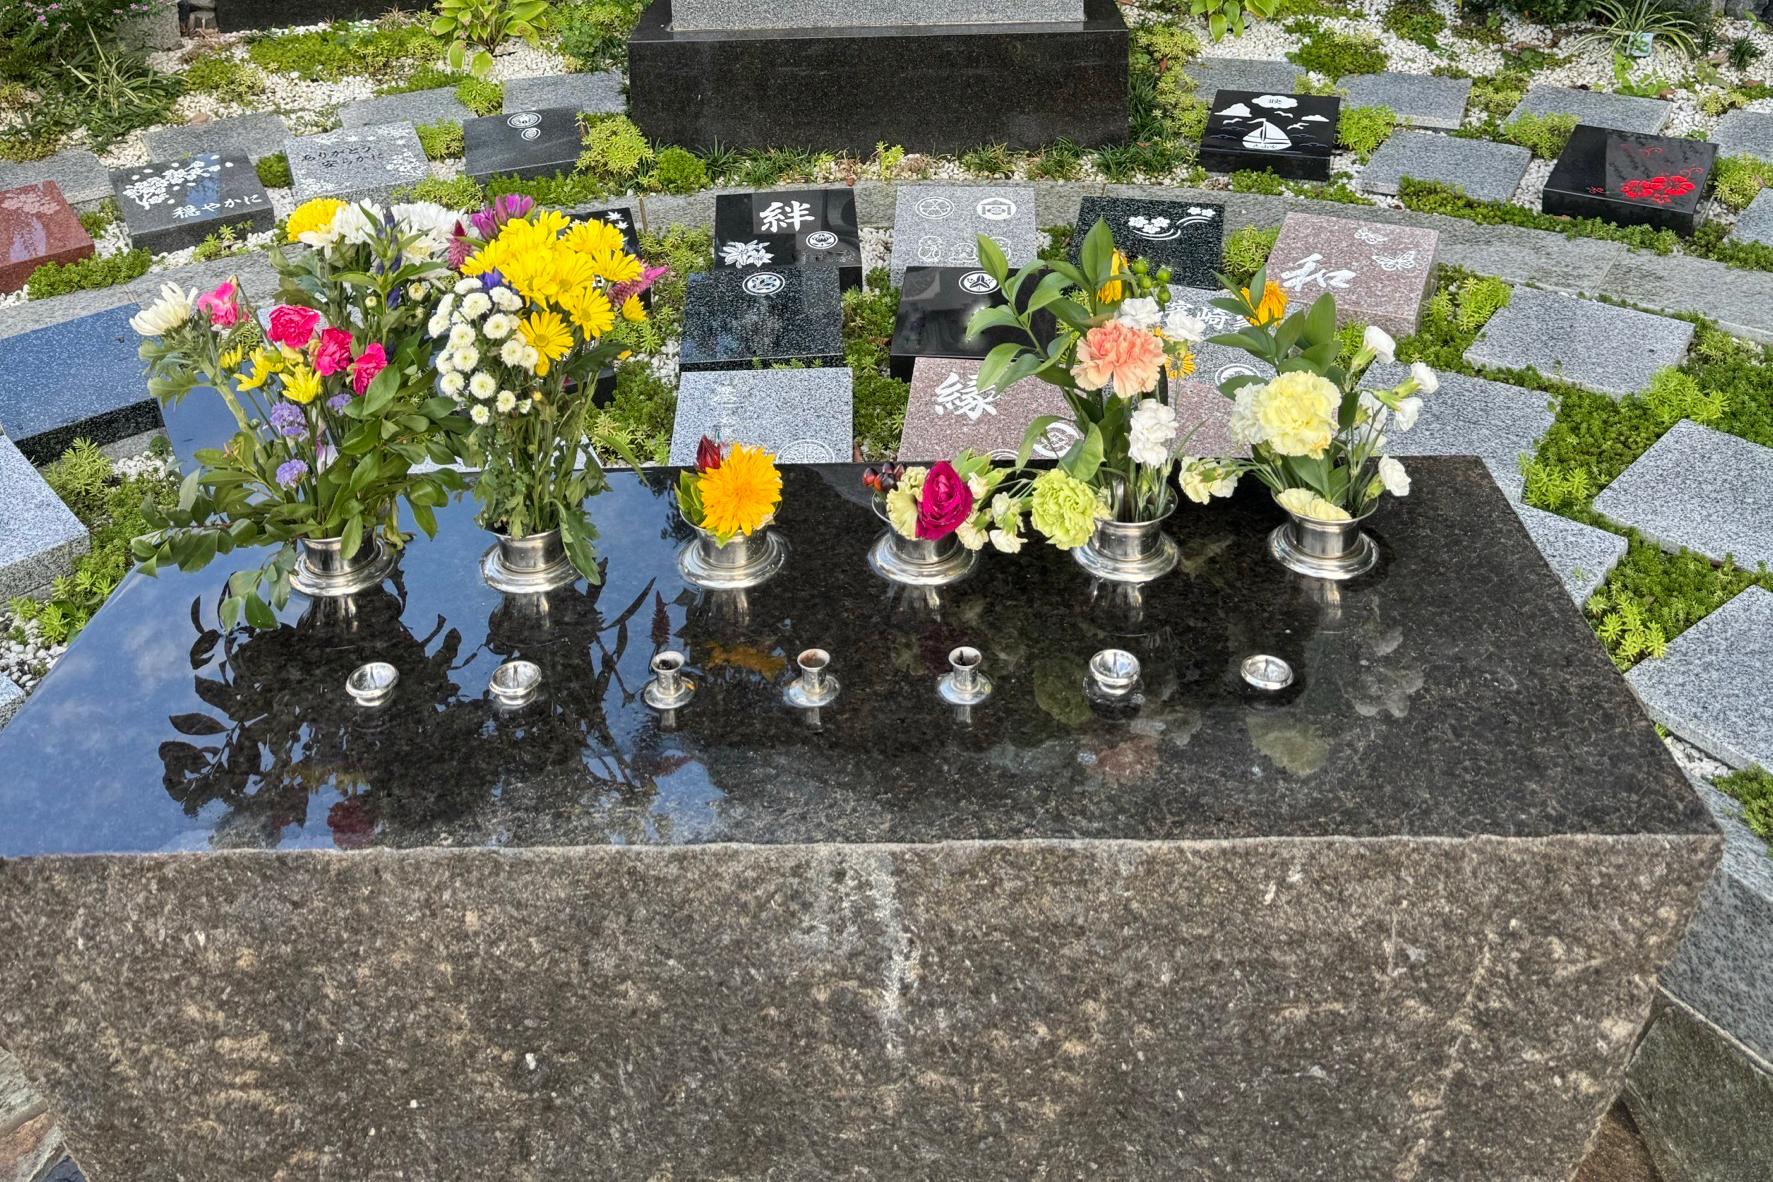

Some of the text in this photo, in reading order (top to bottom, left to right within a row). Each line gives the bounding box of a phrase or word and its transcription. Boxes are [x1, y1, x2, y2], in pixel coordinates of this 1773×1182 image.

[173, 194, 263, 219] 穏やかに
[759, 200, 815, 233] 絆
[1280, 253, 1357, 292] 和
[935, 372, 1001, 421] 縁
